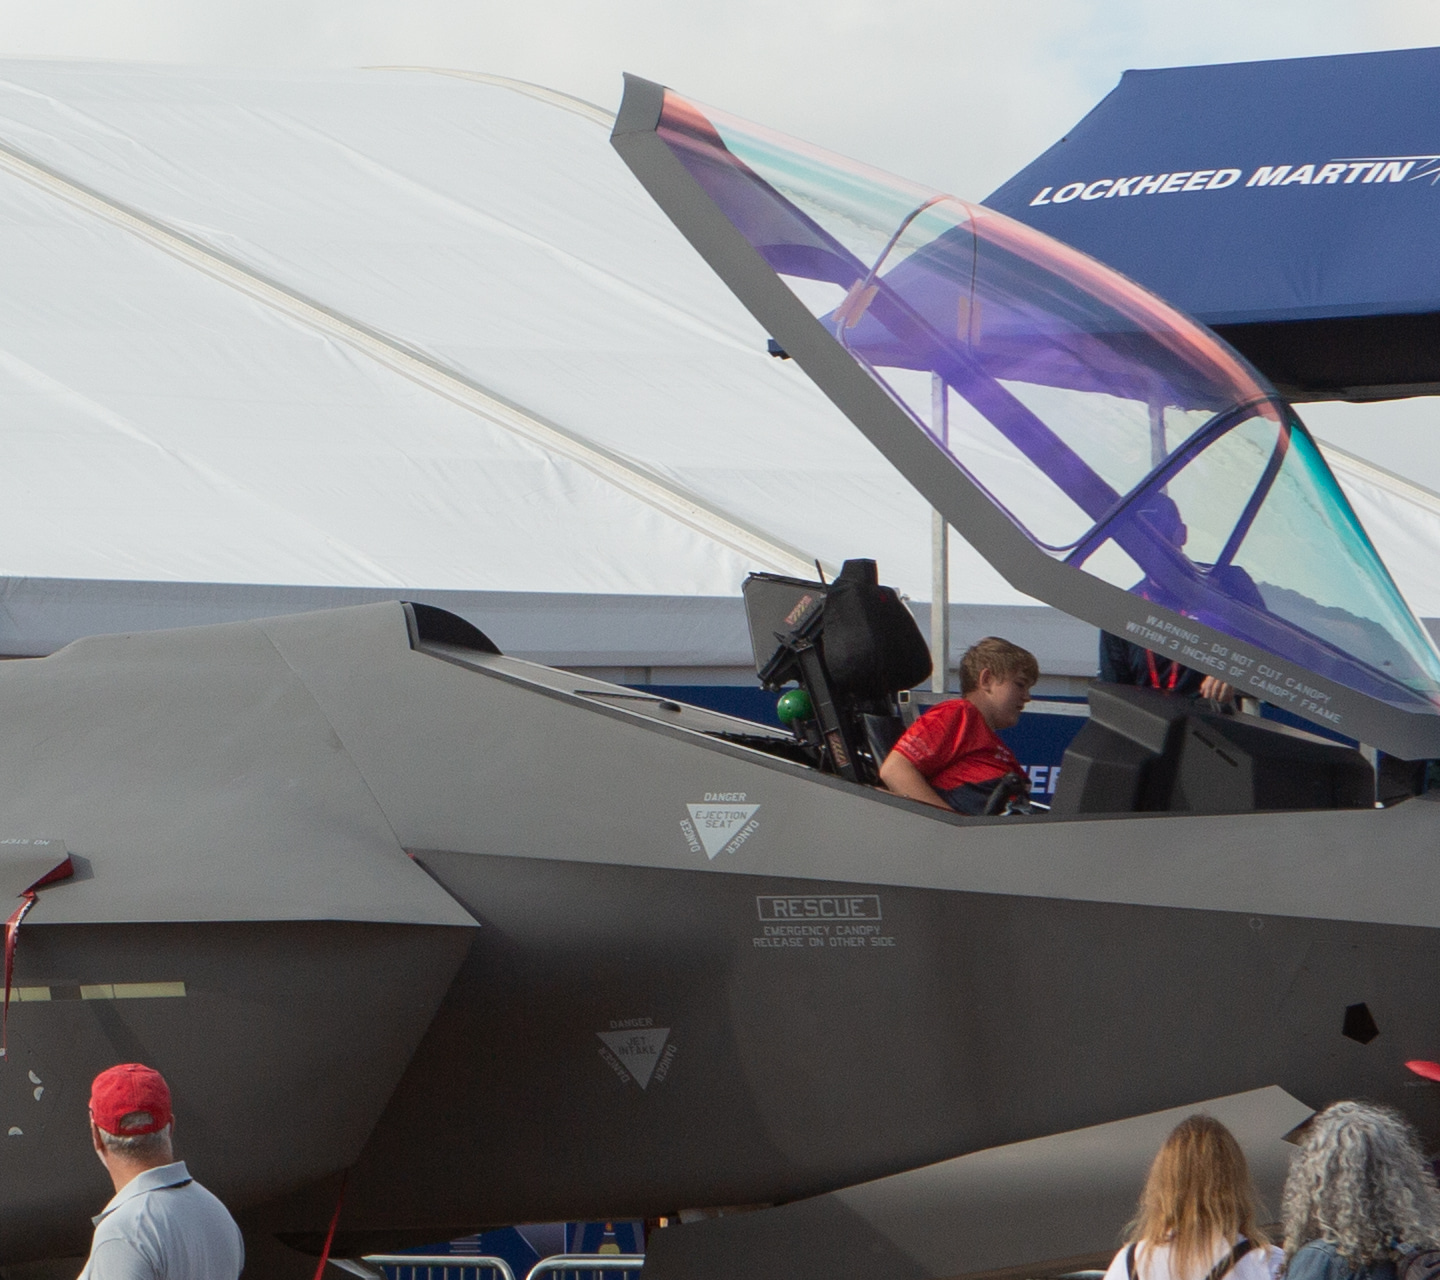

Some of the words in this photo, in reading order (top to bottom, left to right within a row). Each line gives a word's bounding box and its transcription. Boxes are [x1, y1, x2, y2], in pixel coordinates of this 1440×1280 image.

[1029, 168, 1242, 207] LOCKHEED
[1246, 161, 1417, 189] MARTIN
[1146, 615, 1200, 645] WARNING
[1211, 643, 1229, 658] DO
[1230, 651, 1256, 668] NOT
[1257, 664, 1284, 682] CUT
[1285, 677, 1333, 704] CANOPY
[1125, 620, 1167, 646] WITHIN
[1169, 640, 1180, 651] 3
[1181, 646, 1226, 672] INCHES
[1228, 666, 1247, 679] OF
[1249, 675, 1298, 703] CANOPY
[1300, 697, 1343, 725] FRAME
[704, 792, 747, 802] DANGER
[695, 810, 748, 820] EJECTION
[705, 819, 734, 829] SEAT
[679, 818, 702, 853] DANGER
[726, 820, 760, 855] DANGER
[773, 899, 866, 918] RESCUE
[763, 926, 830, 936] EMERGENCY
[836, 926, 881, 936] CANOPY
[753, 937, 804, 948] RELEASE
[808, 937, 825, 947] ON
[830, 937, 866, 947] OTHER
[871, 937, 897, 947] SIDE
[609, 1017, 654, 1029] DANGER
[654, 1044, 677, 1082] DANGER
